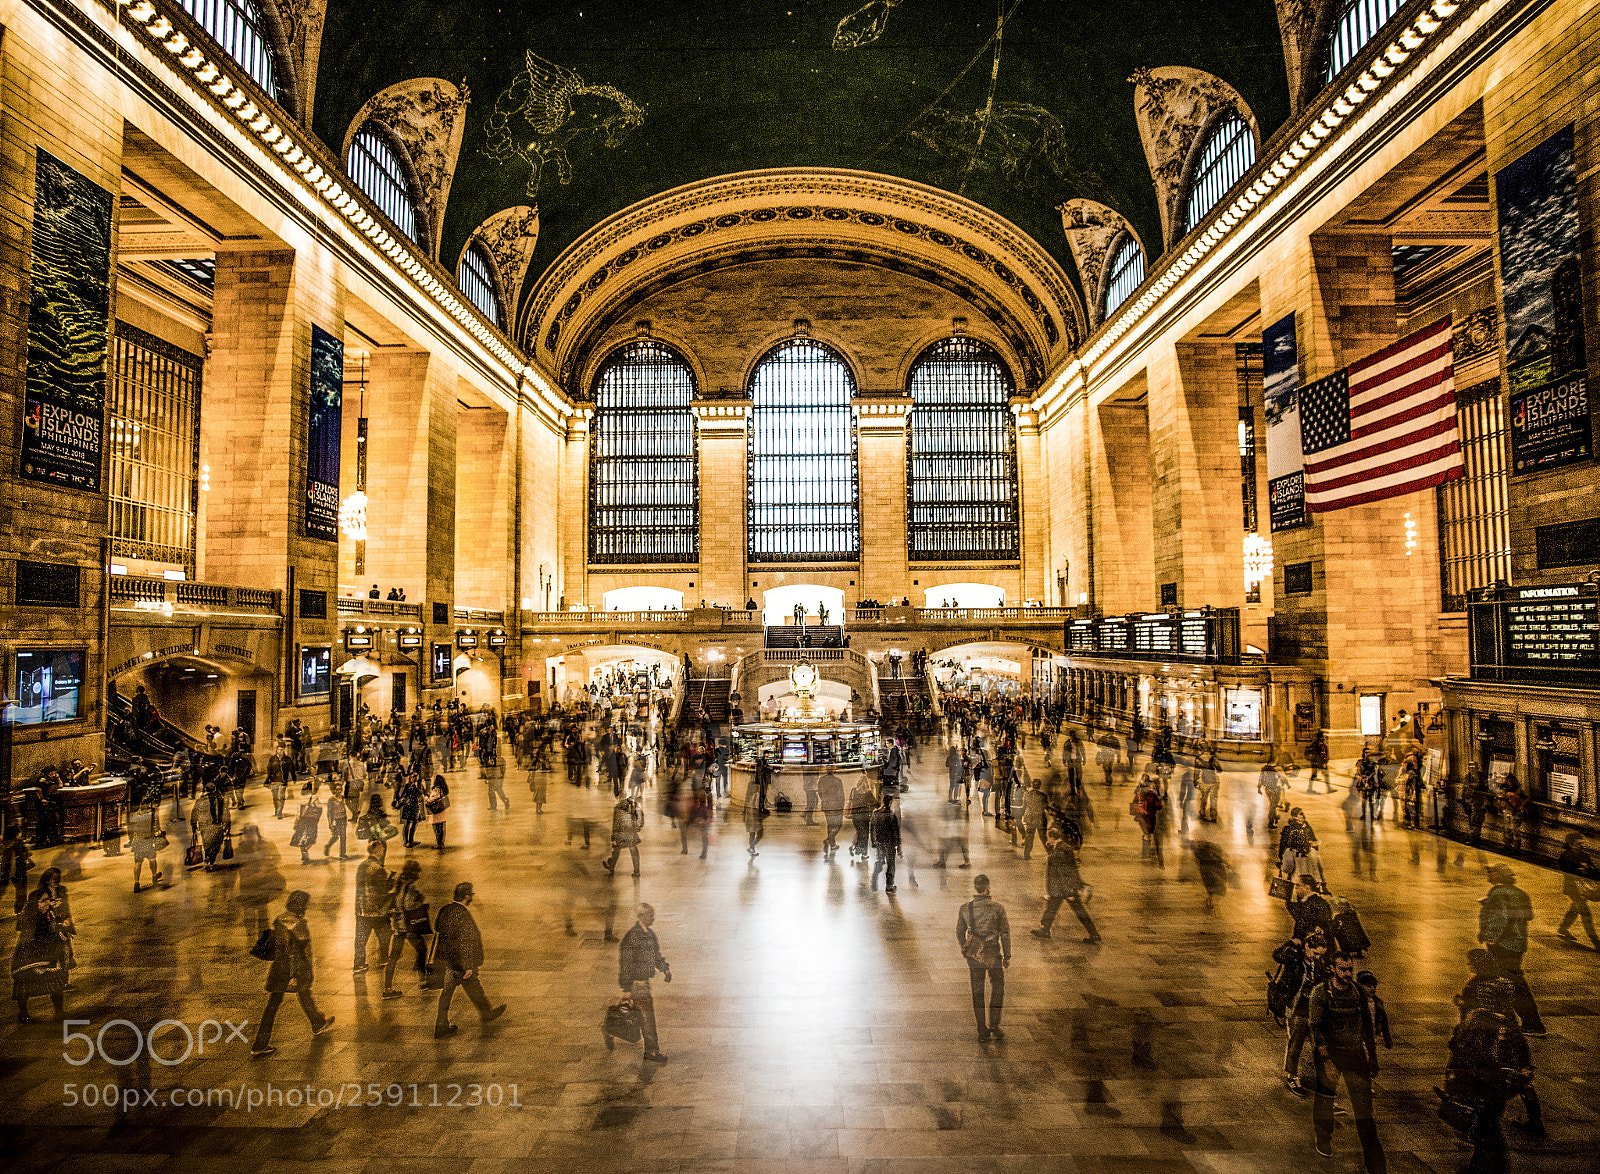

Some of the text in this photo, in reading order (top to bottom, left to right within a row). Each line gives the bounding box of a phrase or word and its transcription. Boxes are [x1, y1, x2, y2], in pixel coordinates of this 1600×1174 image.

[1527, 379, 1586, 409] EXPLORE
[1527, 391, 1587, 422] ISLANDS
[42, 402, 100, 432] EXPLORE
[1527, 406, 1588, 431] PHILIPPINES
[42, 416, 100, 444] ISLANDS
[41, 430, 99, 453] PHILIPPINES
[41, 441, 55, 451] MAY
[1276, 475, 1302, 490] EXPLORE
[1276, 484, 1303, 500] ISLANDS
[1520, 587, 1578, 598] INFORMATION
[159, 643, 193, 657] BUILDING
[231, 646, 253, 659] STREET
